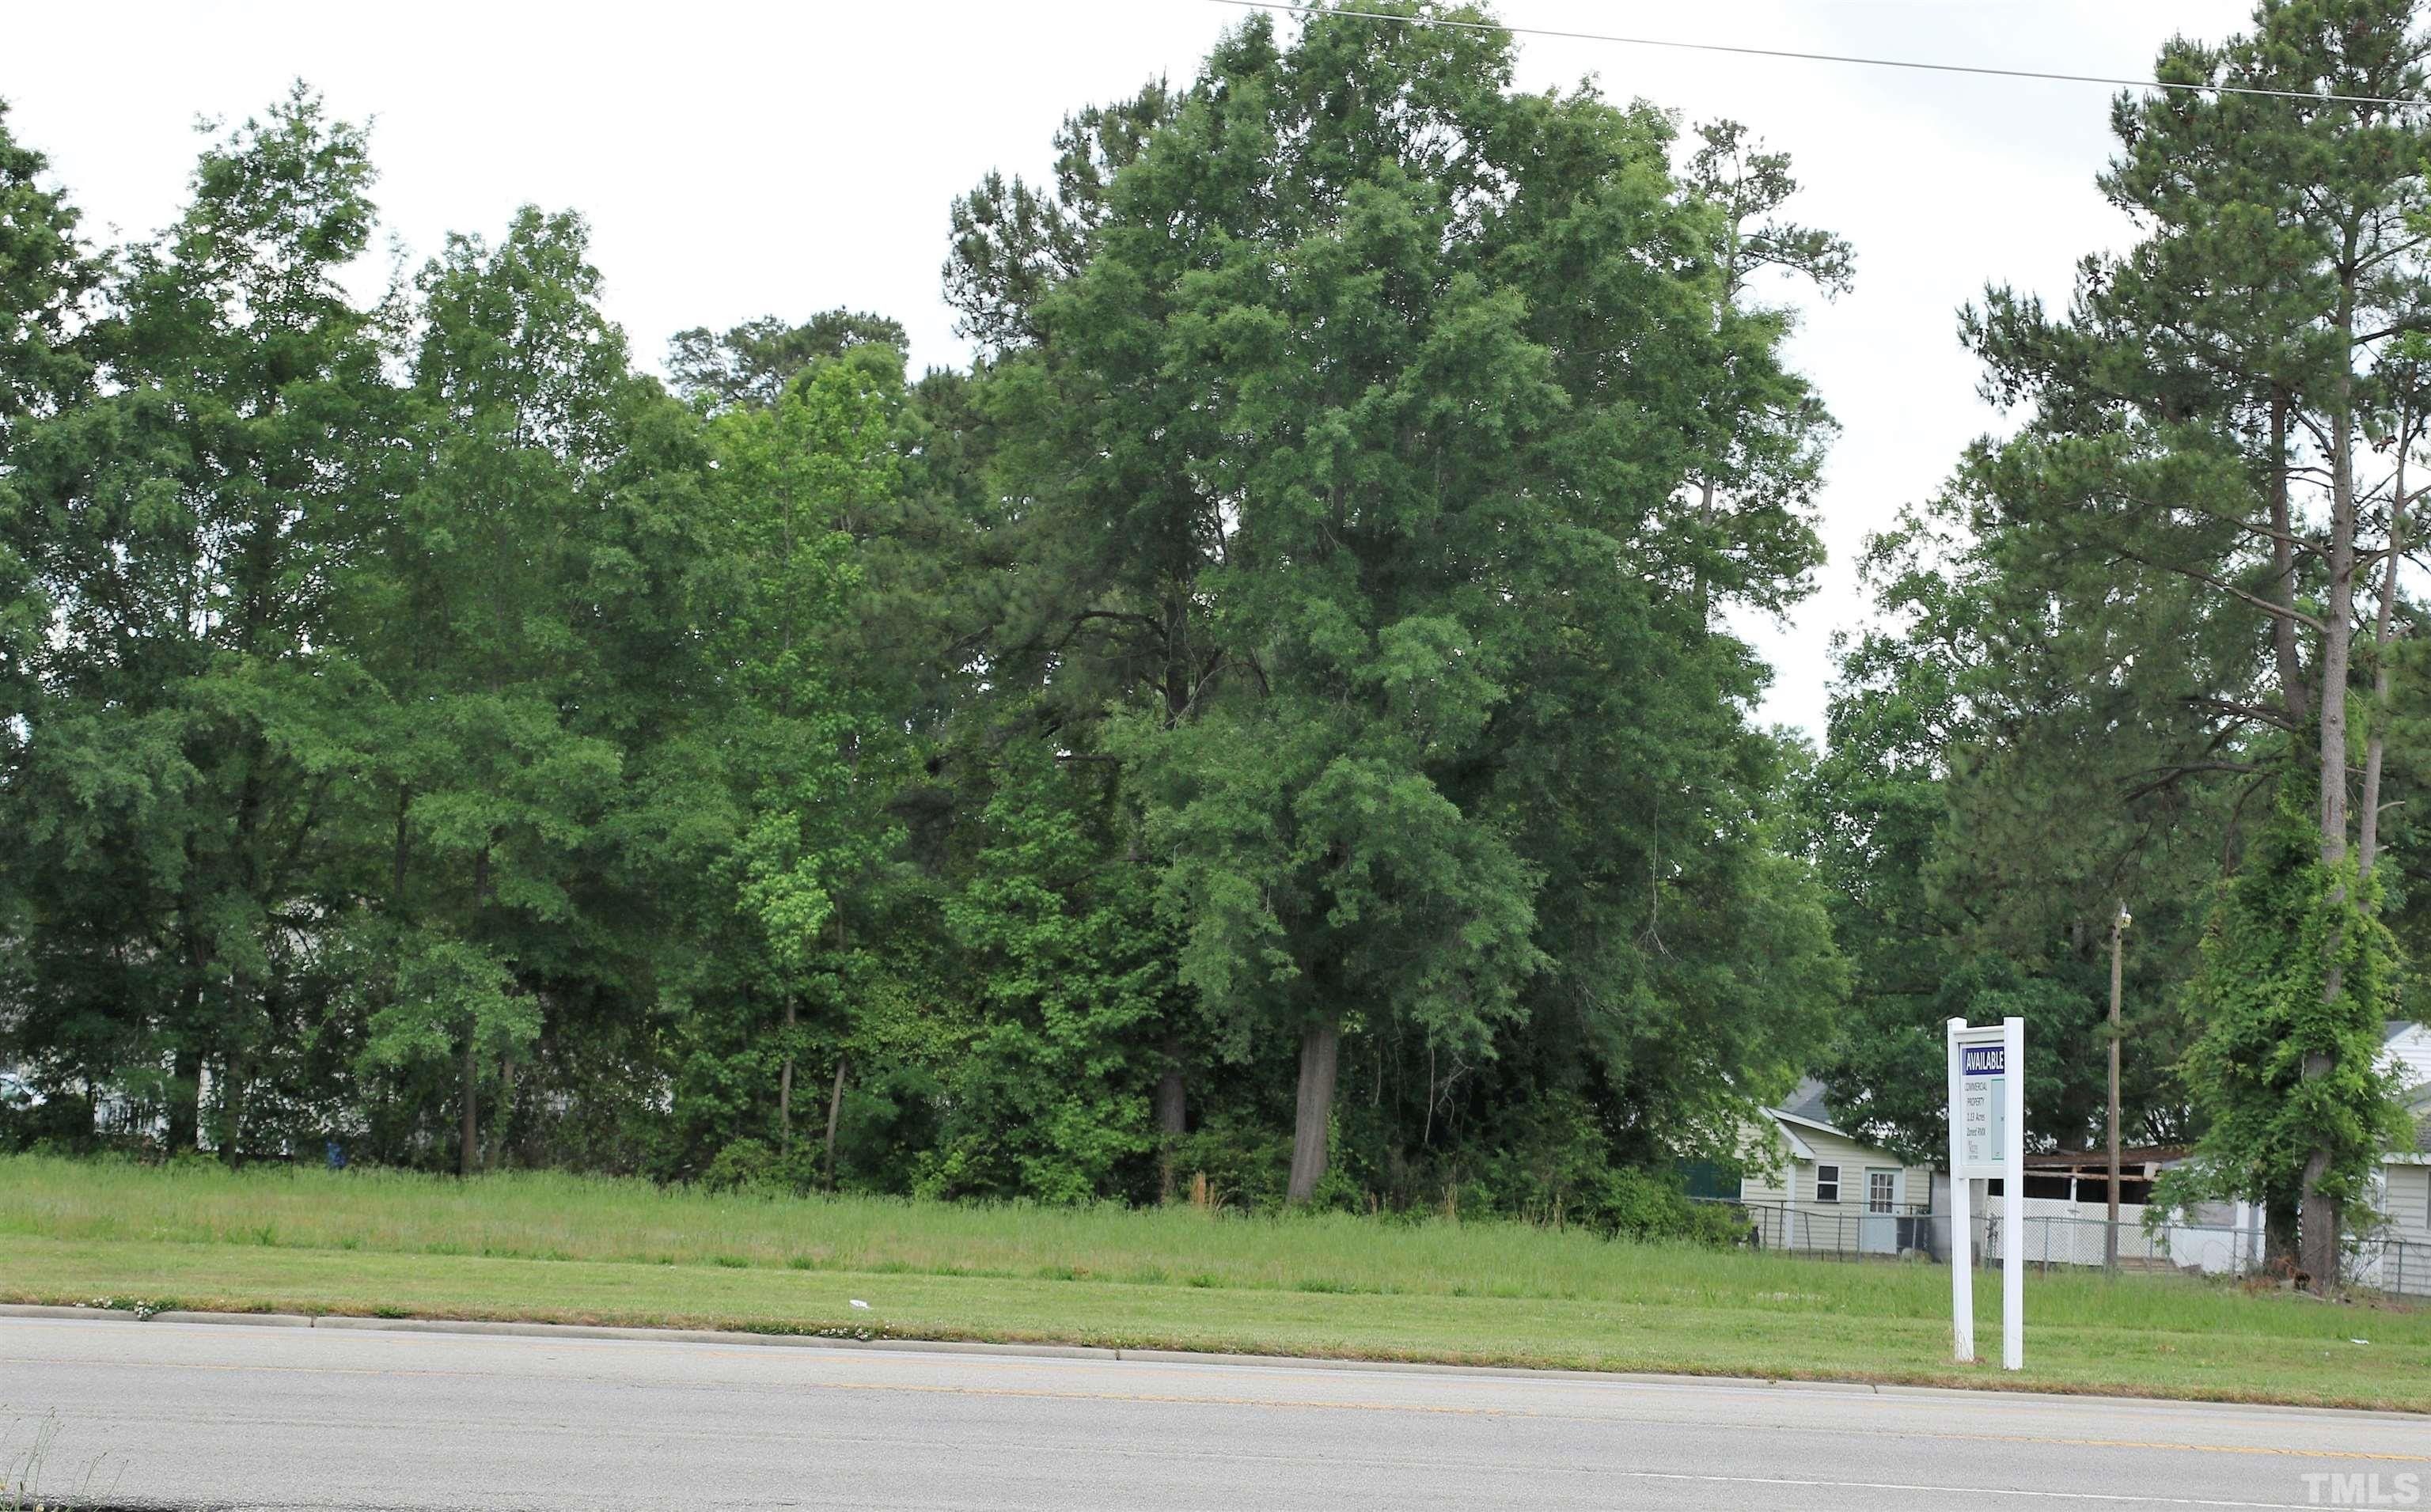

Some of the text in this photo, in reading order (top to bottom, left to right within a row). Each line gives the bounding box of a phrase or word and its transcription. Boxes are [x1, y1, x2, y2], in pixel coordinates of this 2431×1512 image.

[1966, 1051, 2004, 1071] AVAILABLE
[1964, 1082, 1987, 1091] COMMERCIAL
[1966, 1097, 1985, 1106] PROPERTY
